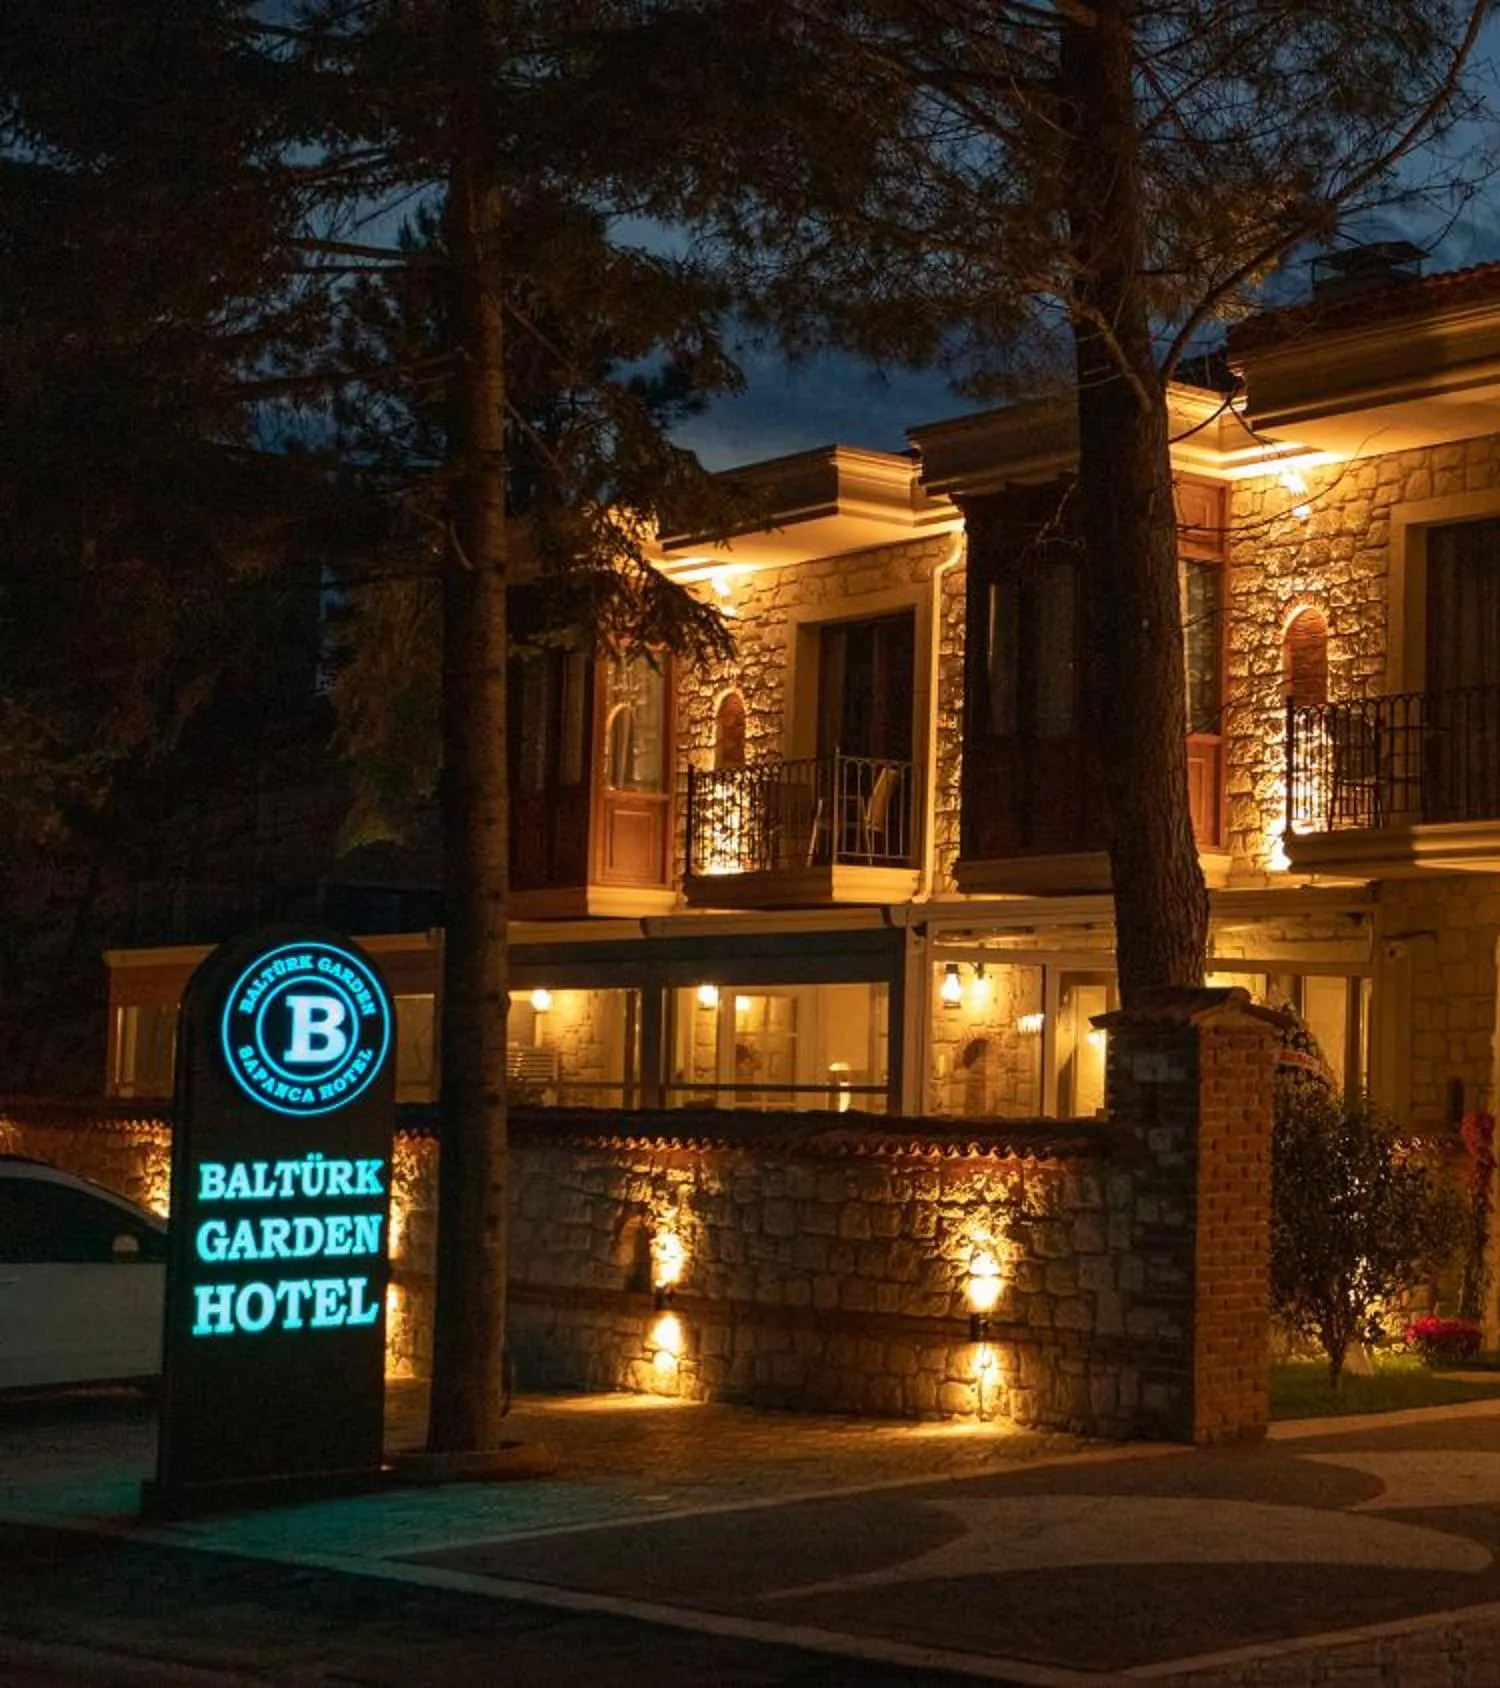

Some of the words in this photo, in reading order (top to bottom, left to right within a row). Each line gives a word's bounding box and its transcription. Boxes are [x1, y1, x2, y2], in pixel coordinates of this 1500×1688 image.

[238, 954, 314, 1015] BALTÜRK
[317, 956, 377, 1017] GARDEN
[283, 994, 347, 1065] B
[238, 1044, 316, 1104] SAPANCA
[318, 1047, 374, 1101] HOTEL
[199, 1153, 384, 1200] BALTÜRK
[196, 1214, 383, 1262] GARDEN
[192, 1277, 379, 1336] HOTEL
